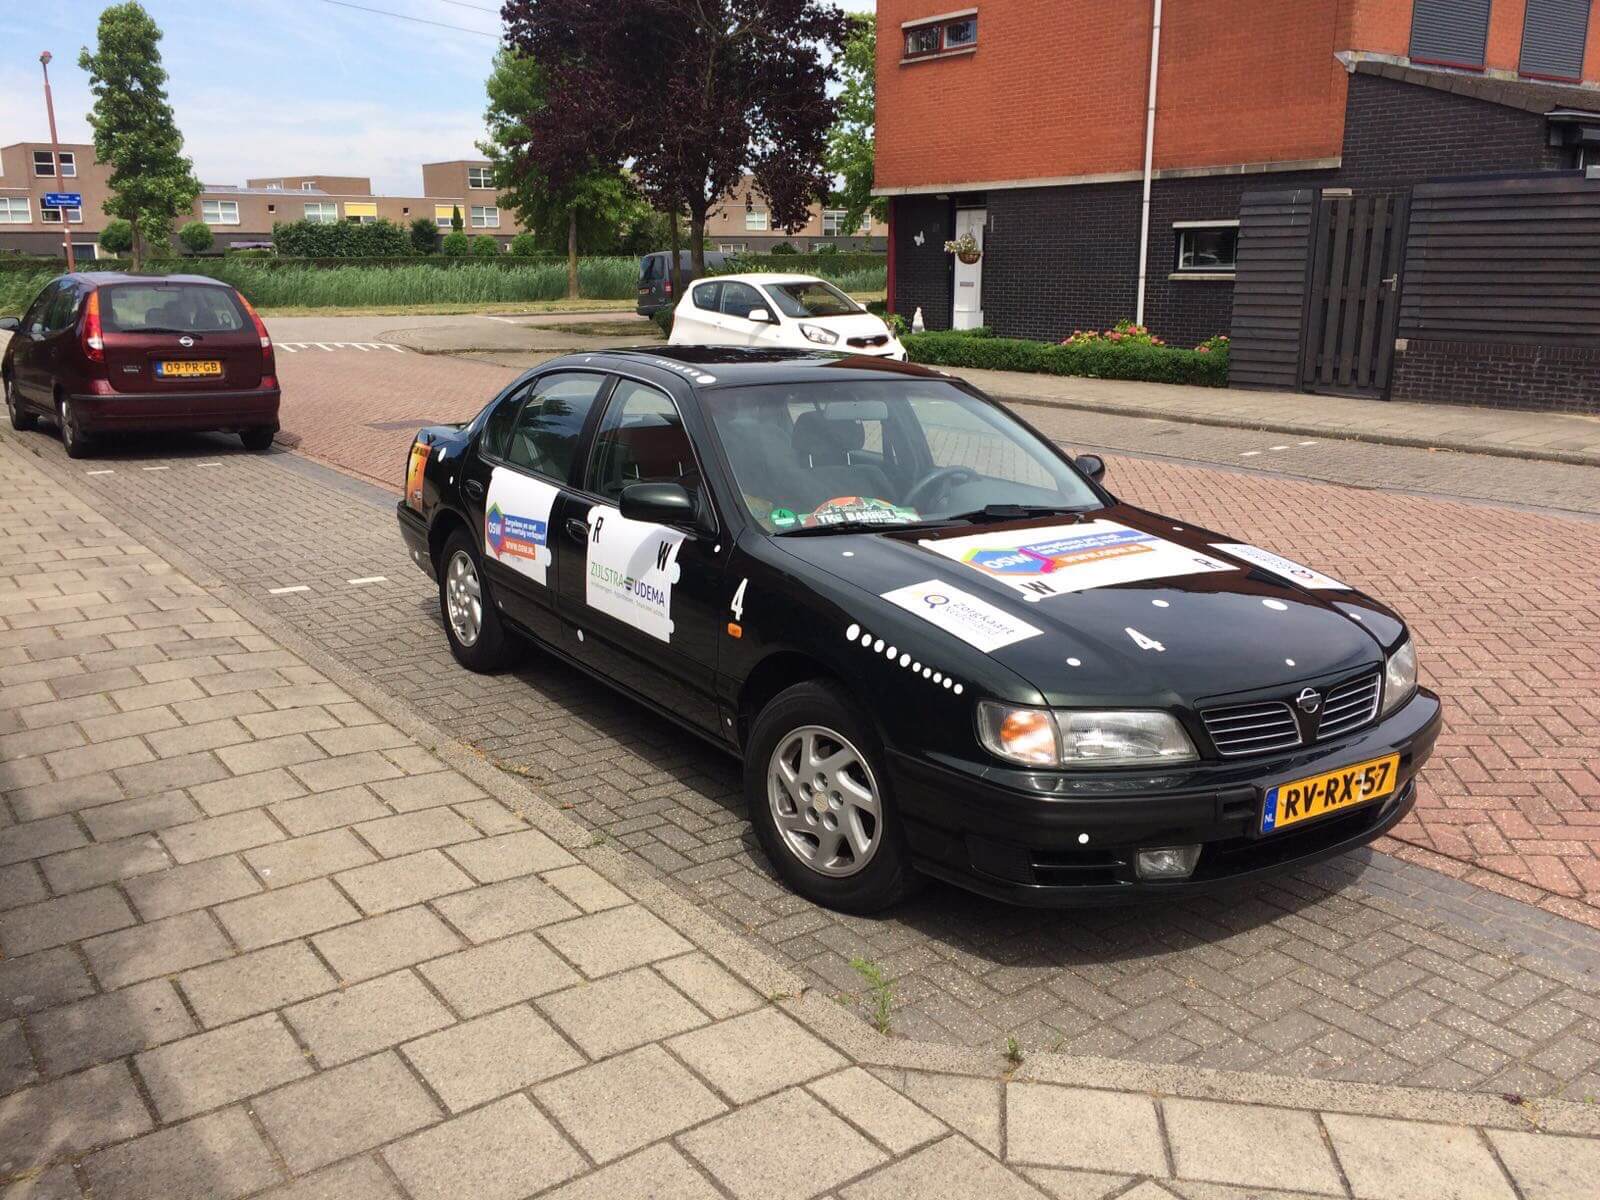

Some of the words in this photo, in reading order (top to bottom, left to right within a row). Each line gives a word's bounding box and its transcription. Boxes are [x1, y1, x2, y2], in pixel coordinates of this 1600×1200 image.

[166, 361, 219, 374] 09-PR-GB
[592, 516, 604, 544] R
[657, 540, 673, 571] W
[982, 552, 1034, 570] OSW
[634, 580, 665, 608] UDEMA
[731, 578, 749, 621] 4
[1020, 580, 1057, 596] W
[1124, 627, 1166, 652] 4
[1264, 813, 1275, 824] NL
[1284, 761, 1391, 820] RV-RX-57
